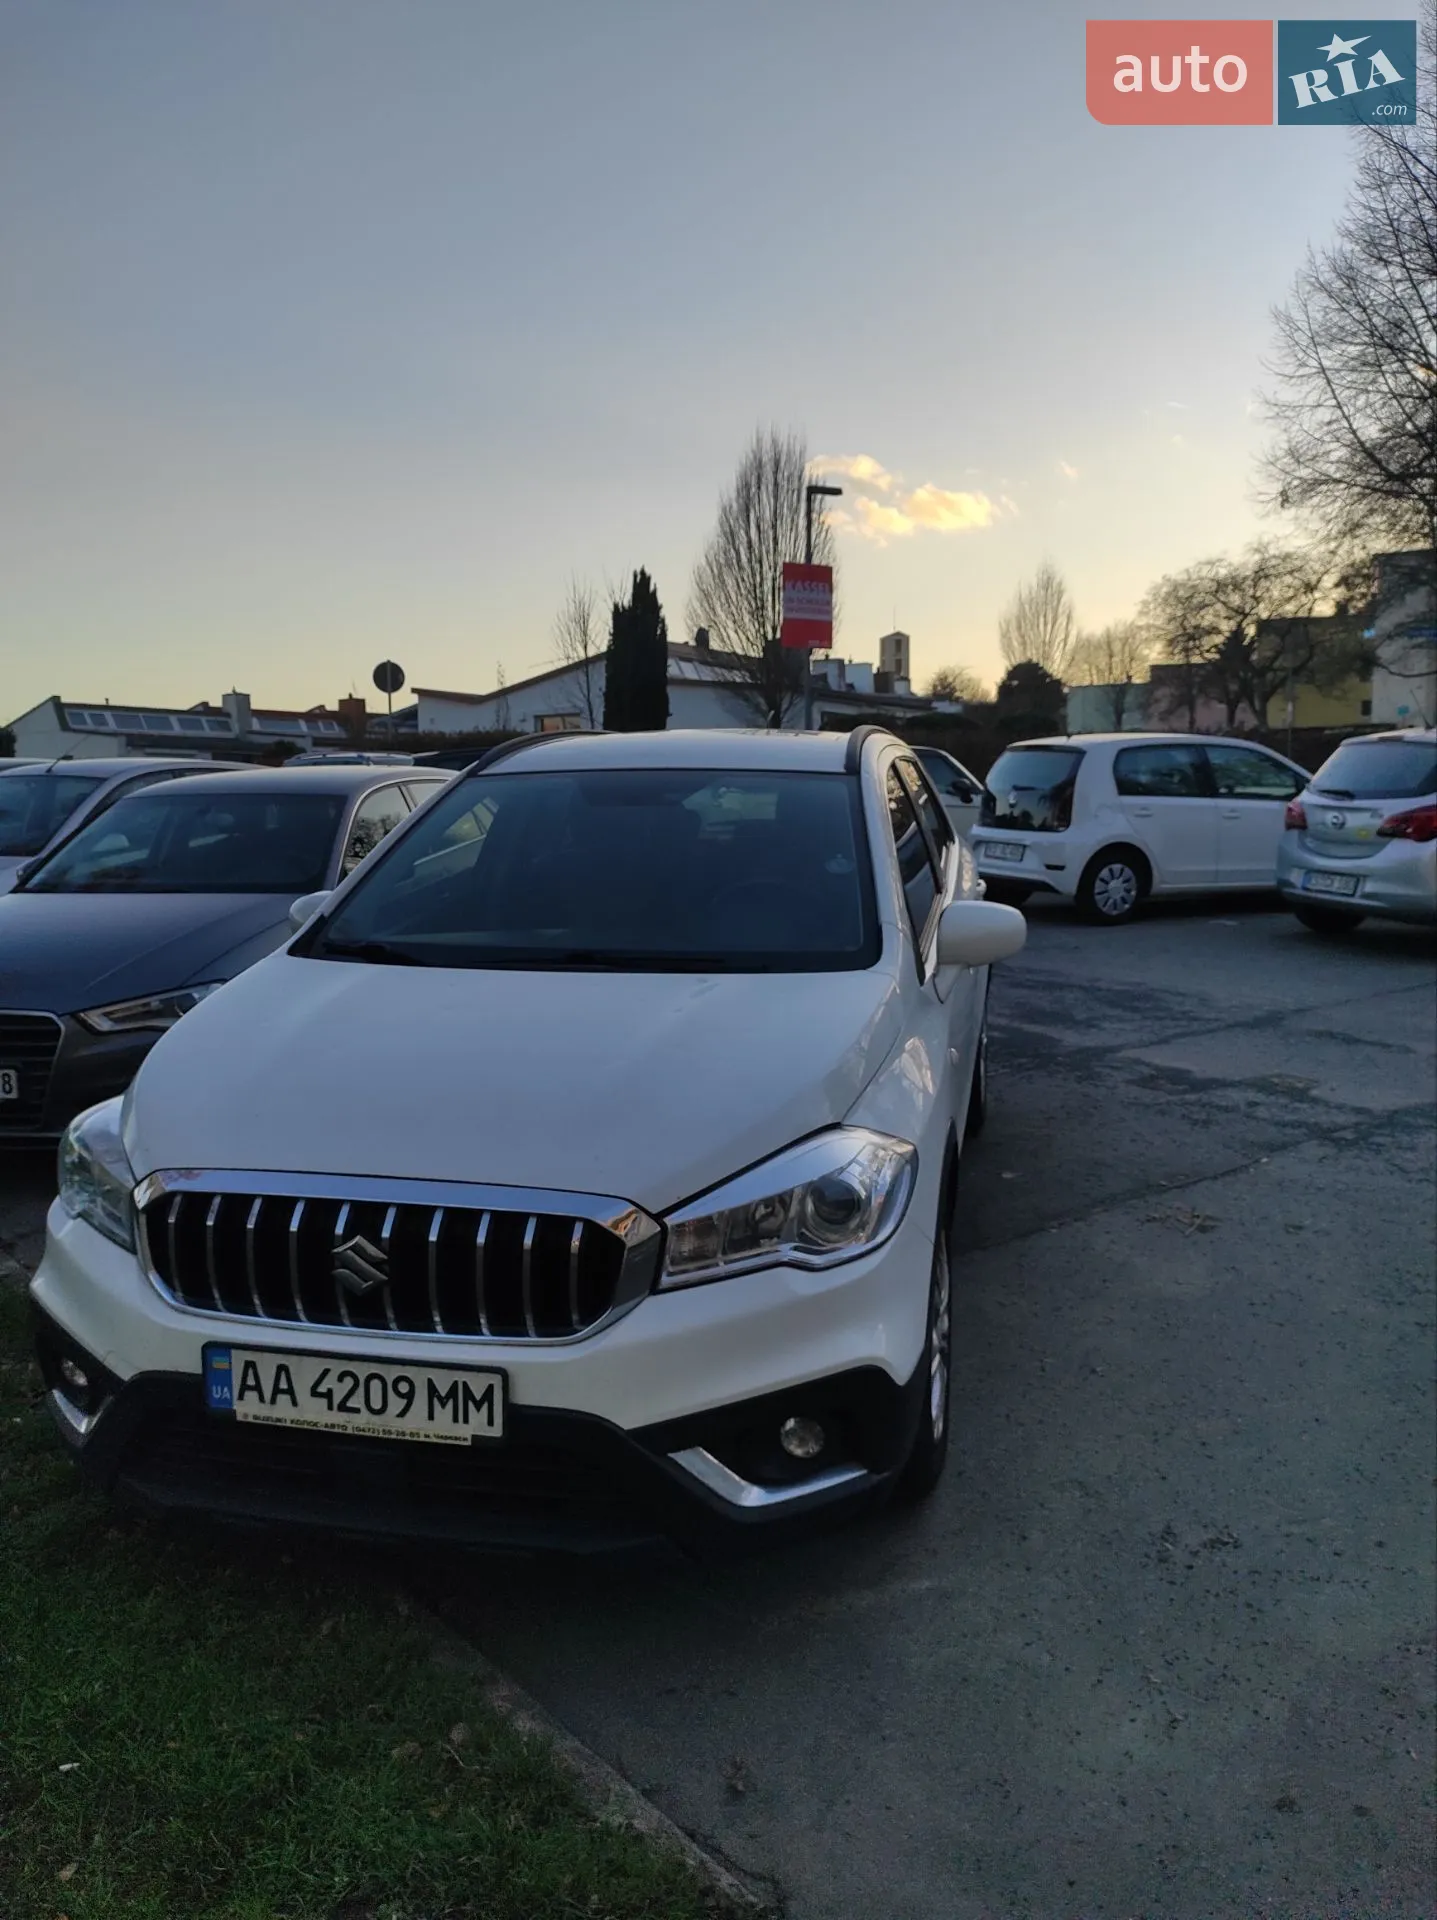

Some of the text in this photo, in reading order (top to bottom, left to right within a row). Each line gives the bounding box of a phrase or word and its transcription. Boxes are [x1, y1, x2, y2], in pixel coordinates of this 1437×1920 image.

[785, 580, 830, 595] KASSEL
[2, 1072, 13, 1095] 8
[212, 1385, 231, 1400] UA
[237, 1359, 495, 1427] AA 4209 MM
